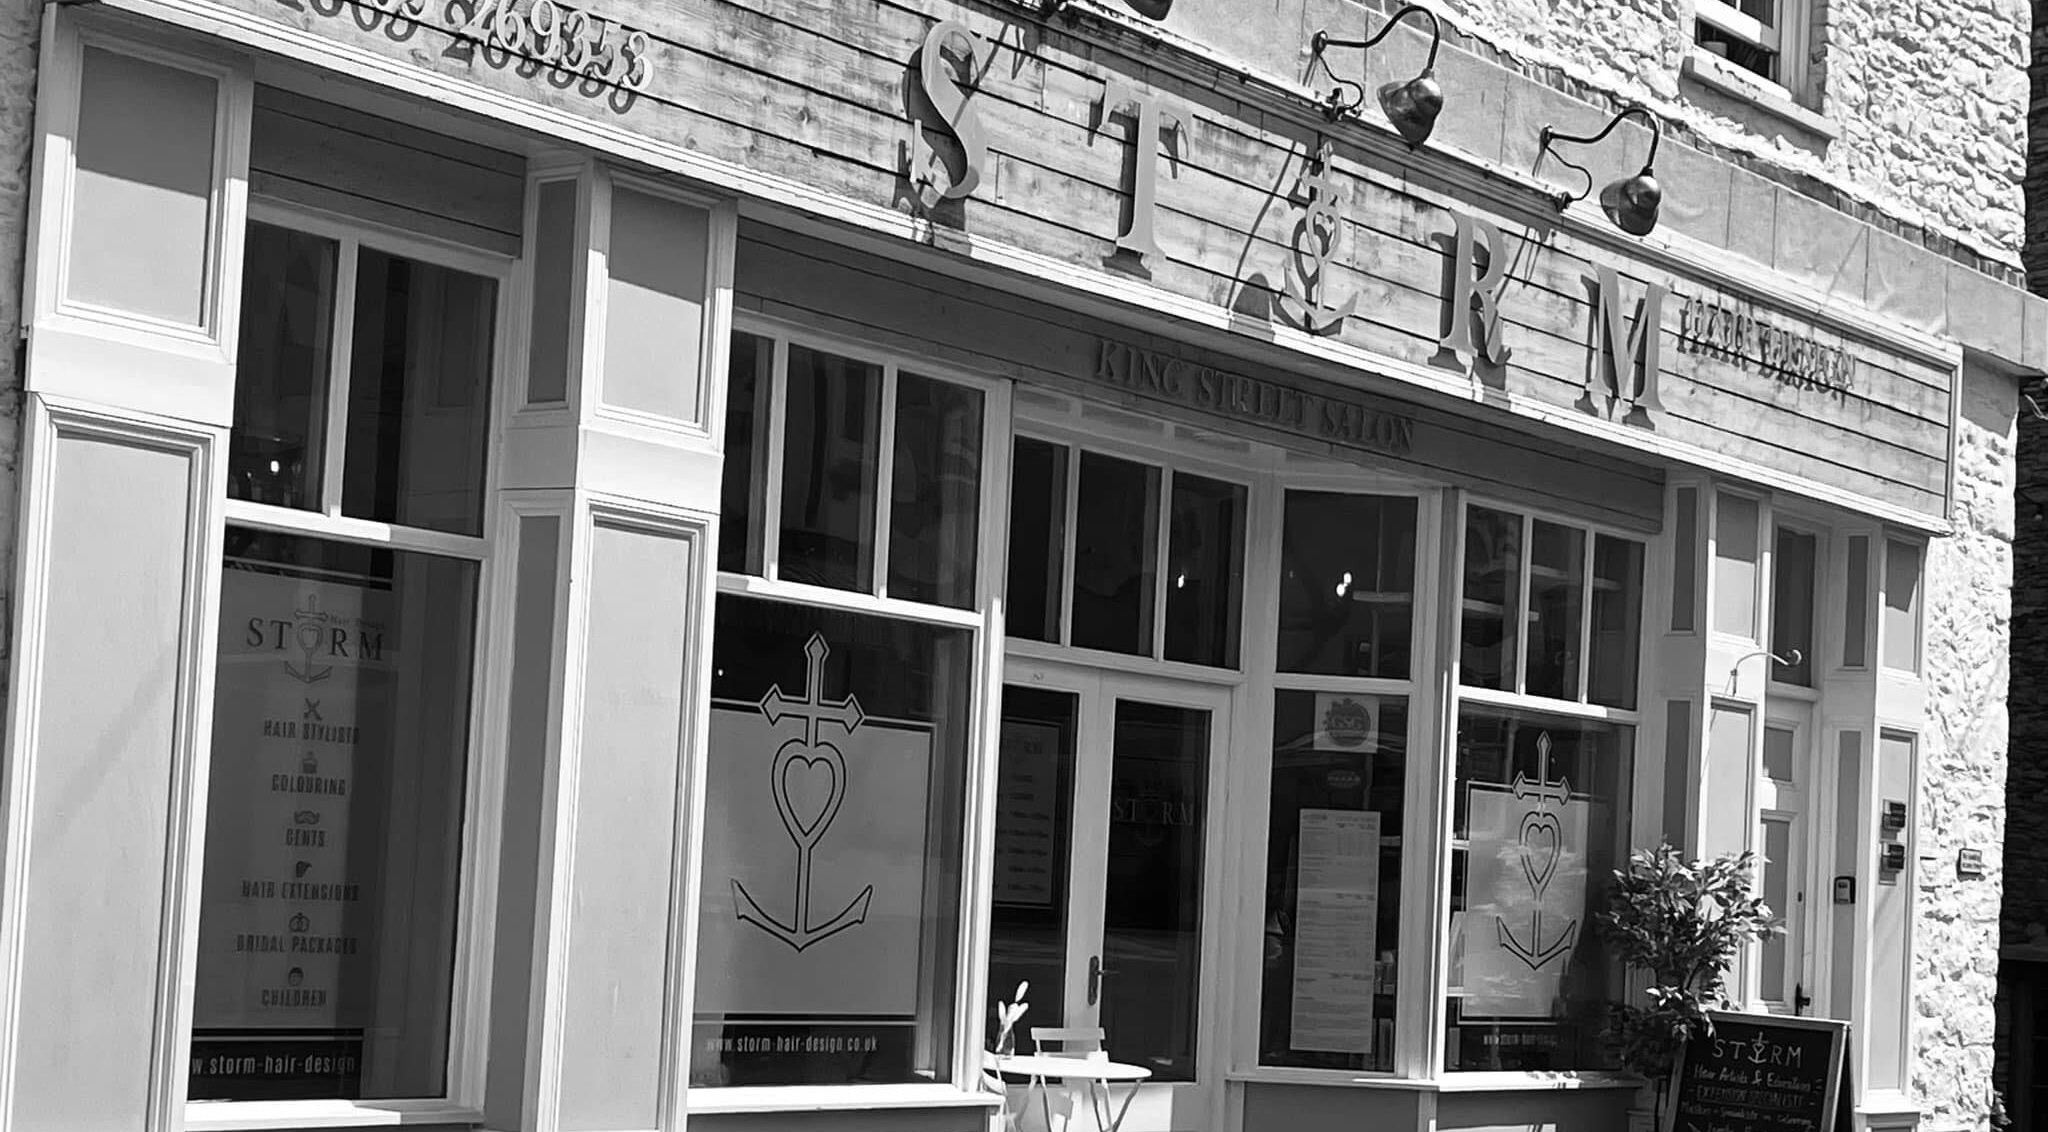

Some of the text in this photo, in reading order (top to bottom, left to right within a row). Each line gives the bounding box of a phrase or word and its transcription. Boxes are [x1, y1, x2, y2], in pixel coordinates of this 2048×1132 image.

[1097, 340, 1414, 453] KING STREET SALON
[263, 720, 361, 745] HAIR STYLISTS
[271, 774, 347, 797] COLOURING
[285, 828, 326, 847] GENTS
[240, 880, 361, 901] HAIR EXTENSIONS
[236, 934, 358, 955] BRIDAL PACKAGES
[261, 989, 327, 1008] CHILDREN
